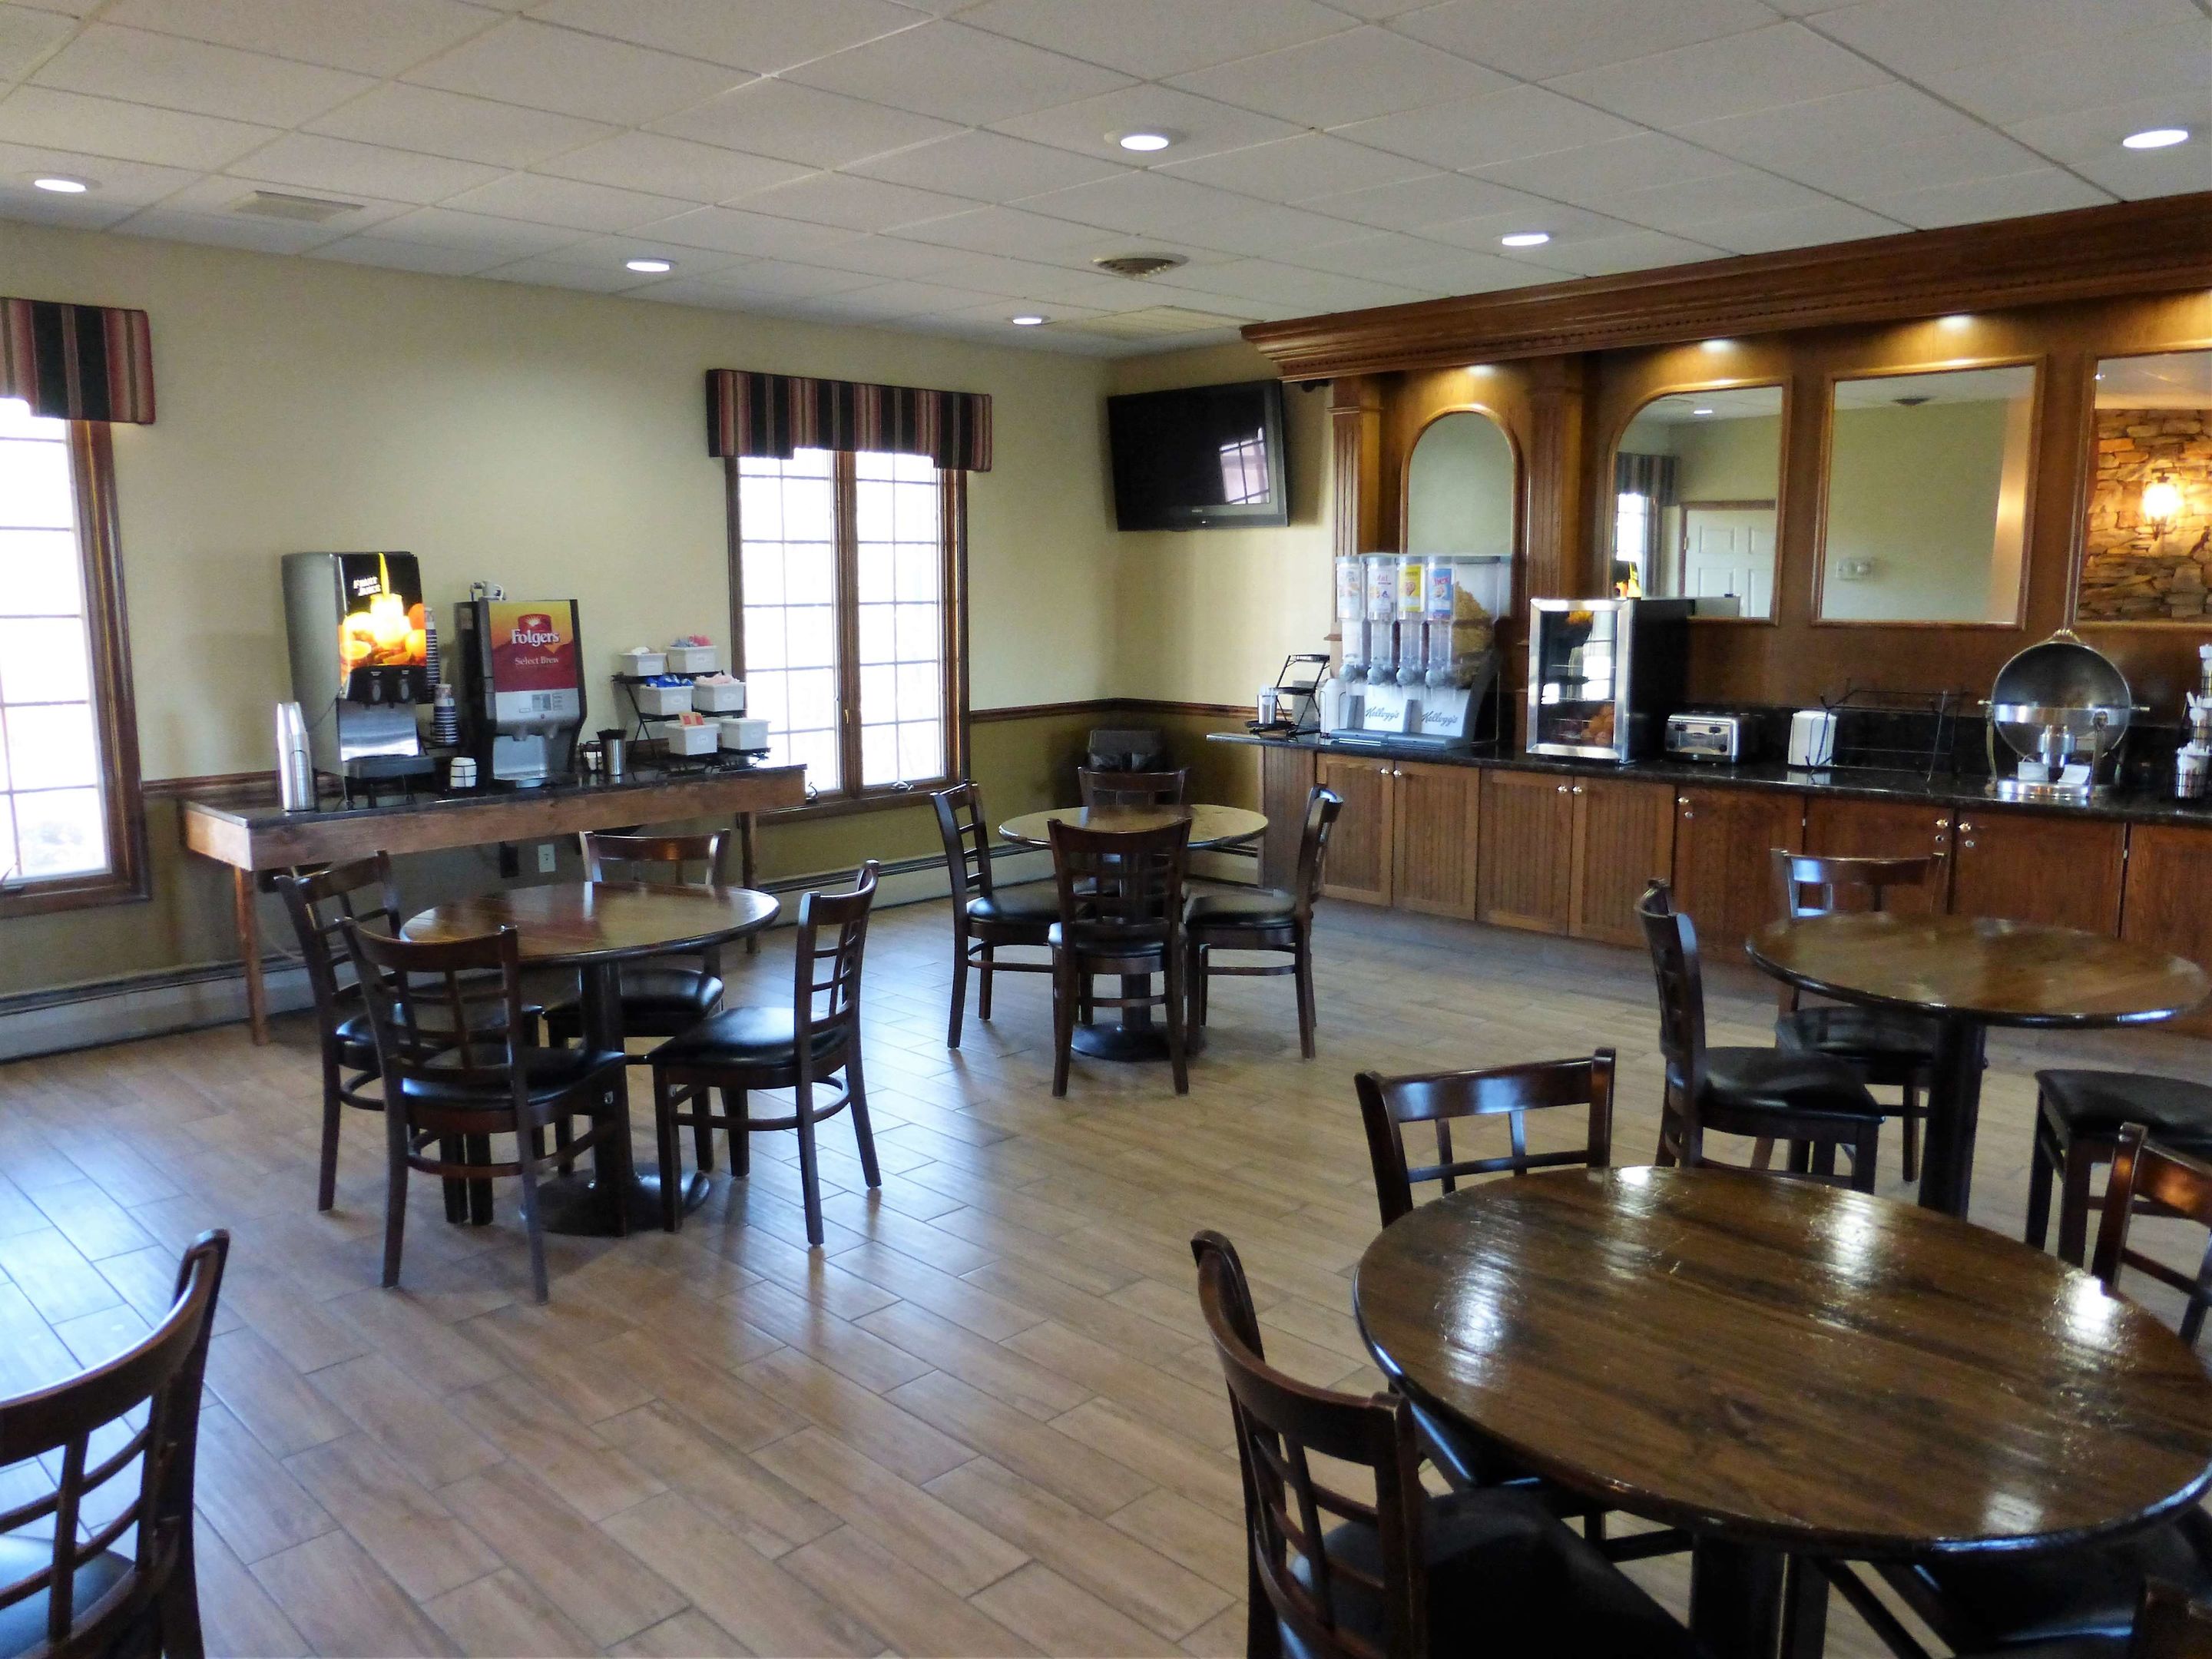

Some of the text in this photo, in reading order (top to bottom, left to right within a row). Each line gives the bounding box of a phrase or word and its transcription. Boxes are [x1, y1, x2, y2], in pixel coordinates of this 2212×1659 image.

[511, 628, 560, 647] Folgers
[515, 657, 538, 665] Select
[1366, 707, 1399, 721] Kellogg's
[1422, 710, 1459, 726] Kellogg's
